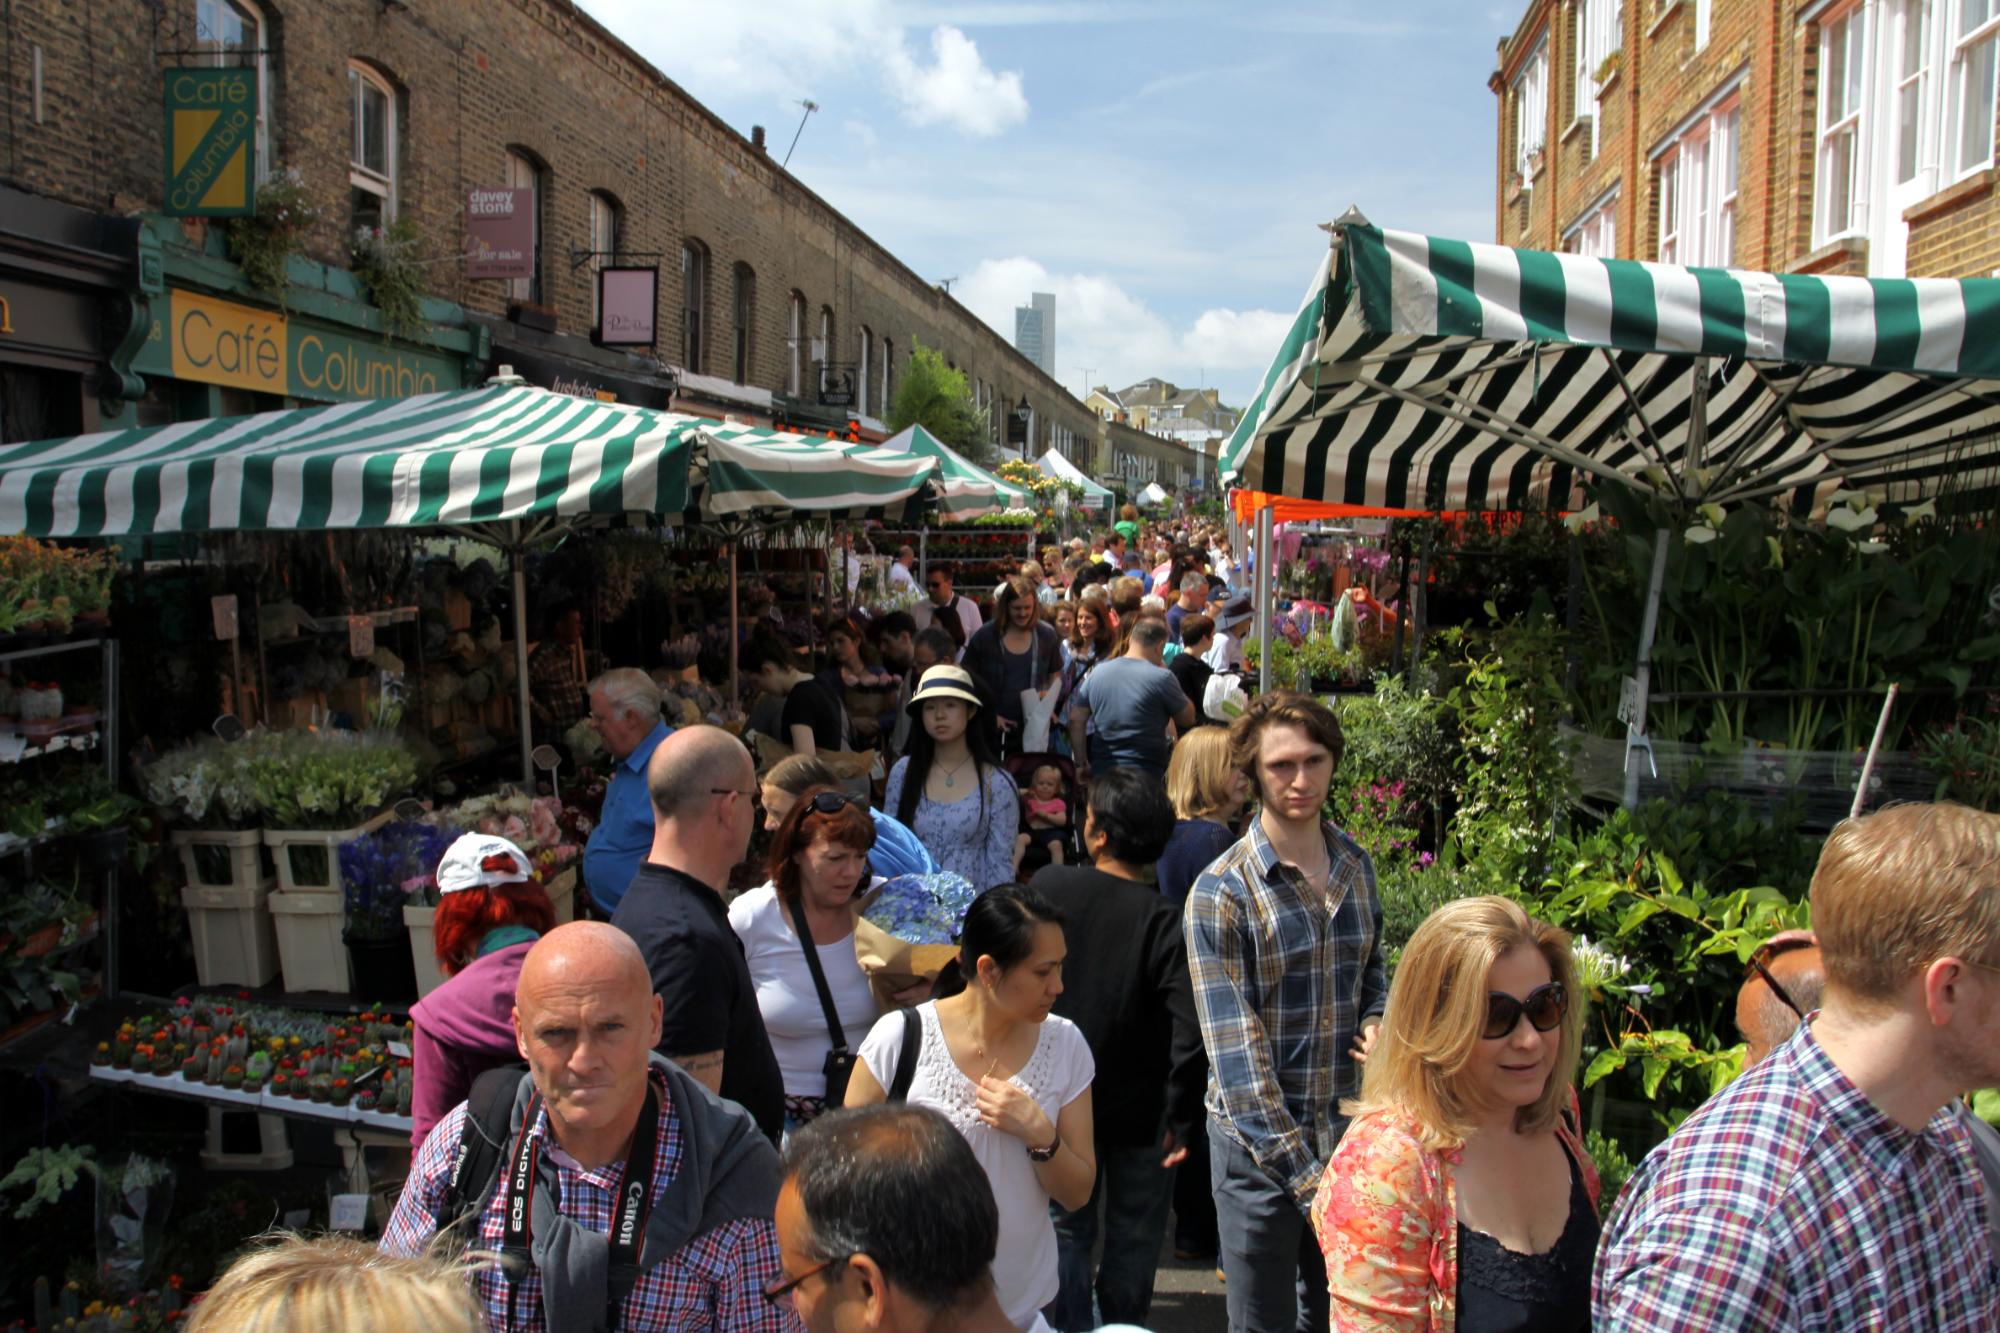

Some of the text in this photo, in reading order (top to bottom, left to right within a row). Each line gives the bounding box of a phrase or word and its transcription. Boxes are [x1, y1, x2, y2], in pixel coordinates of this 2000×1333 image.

[174, 75, 248, 103] Café
[171, 110, 249, 210] Columbia
[470, 189, 514, 204] davey
[470, 201, 514, 214] stone
[181, 309, 280, 380] Café
[512, 1196, 524, 1233] EOS
[619, 1181, 643, 1245] Canon
